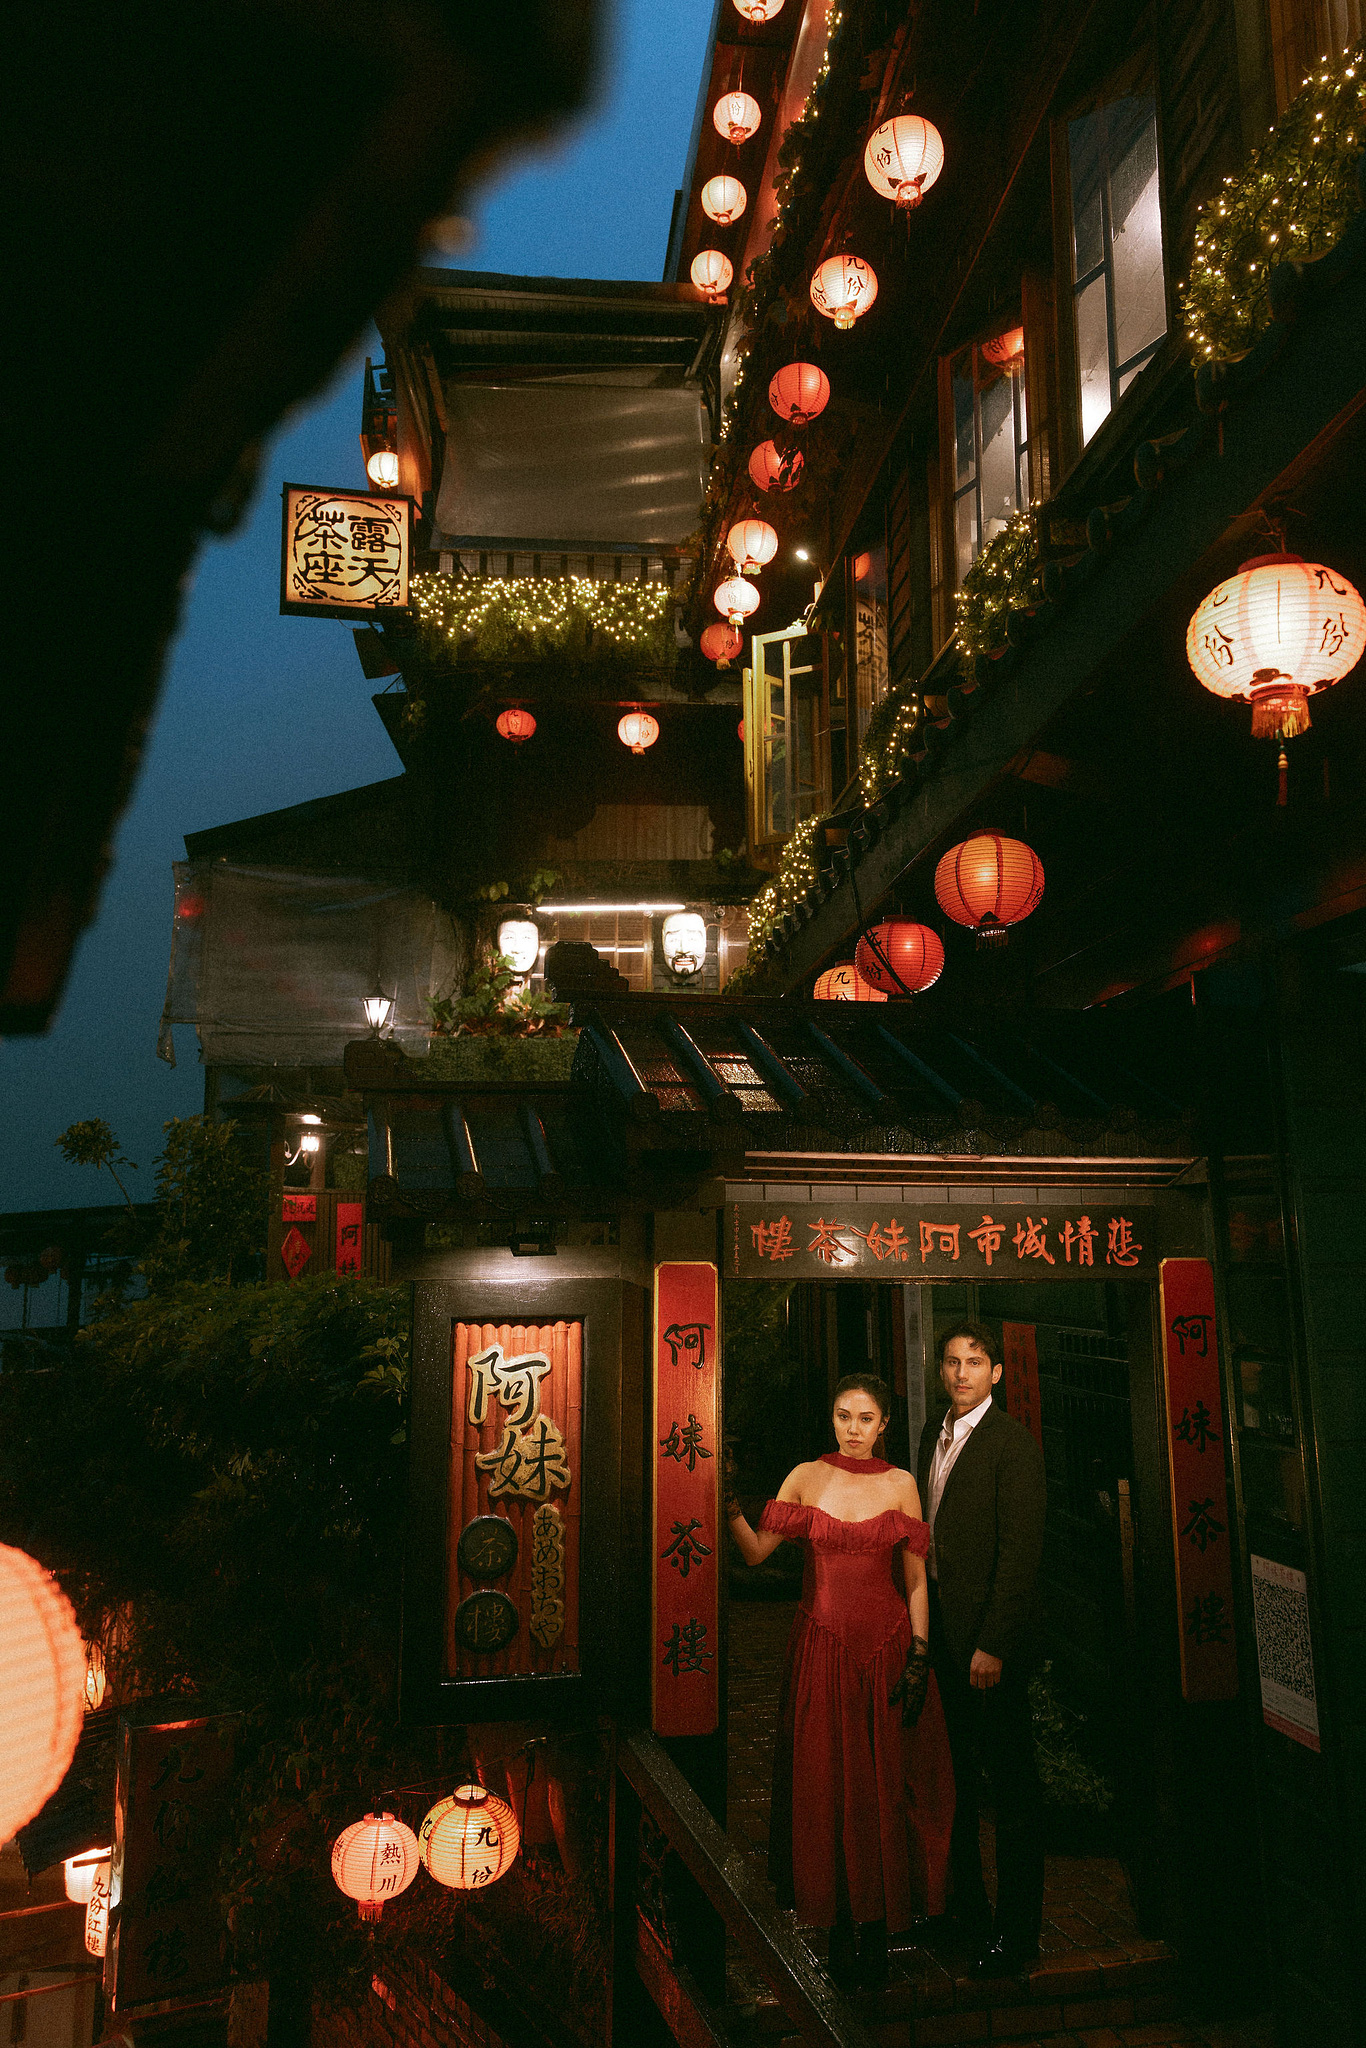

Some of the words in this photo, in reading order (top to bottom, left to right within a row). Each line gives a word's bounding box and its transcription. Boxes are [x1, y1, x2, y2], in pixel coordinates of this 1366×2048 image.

[847, 258, 865, 297] 九份
[1313, 568, 1350, 657] 九份
[641, 716, 652, 739] 九份
[750, 1214, 1143, 1267] 悲情城市阿妹茶樓
[471, 1348, 568, 1497] 阿妹
[659, 1322, 714, 1676] 阿妹茶樓
[1171, 1313, 1230, 1646] 阿妹茶樓
[466, 1529, 511, 1646] 茶樓
[534, 1509, 561, 1648] あめおちや
[377, 1842, 401, 1893] 熱川
[472, 1826, 499, 1886] 九份
